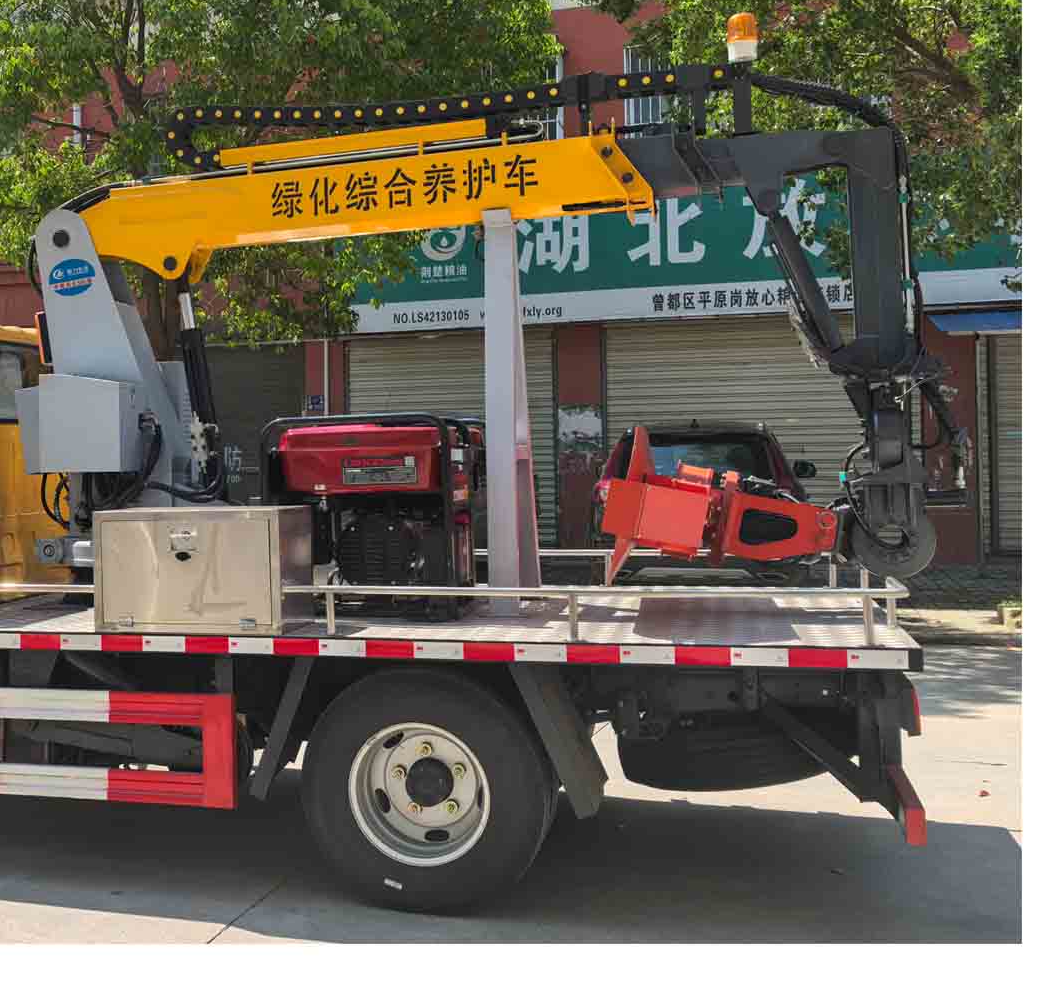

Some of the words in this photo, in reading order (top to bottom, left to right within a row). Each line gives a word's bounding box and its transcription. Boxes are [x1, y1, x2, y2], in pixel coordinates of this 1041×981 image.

[271, 154, 540, 219] 绿化综合养护车
[651, 282, 855, 312] 曾都区平原岗放心粮锁店
[392, 309, 470, 324] NO.LS42130105
